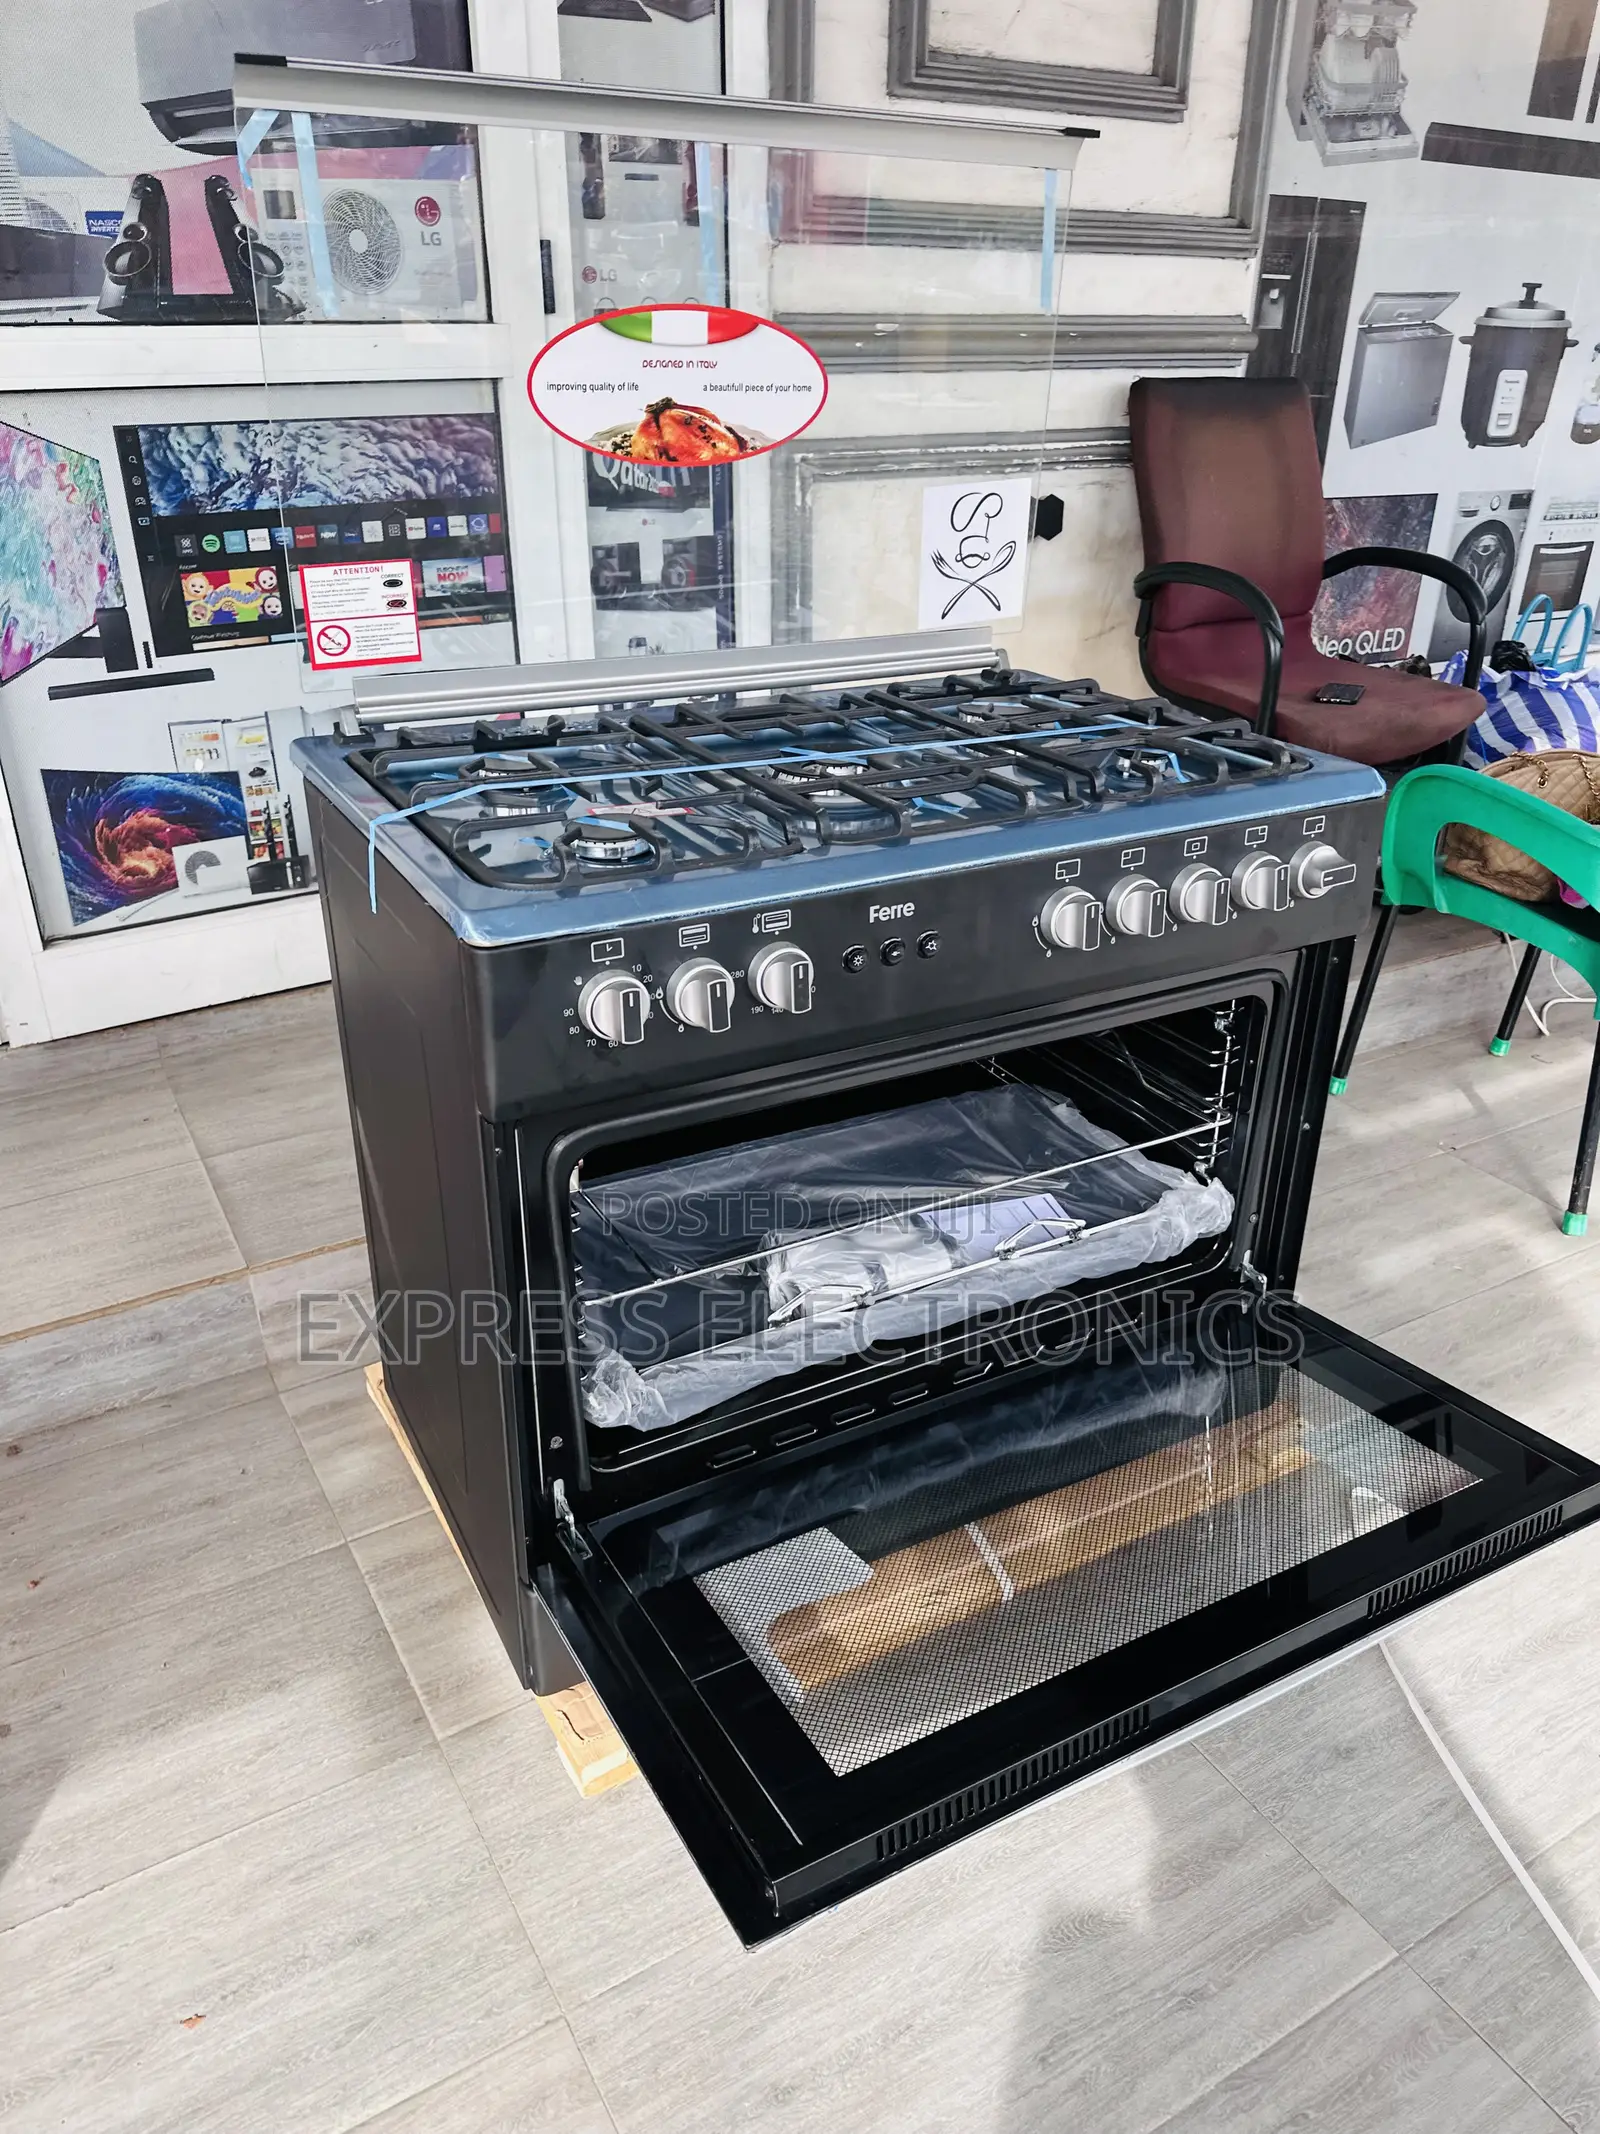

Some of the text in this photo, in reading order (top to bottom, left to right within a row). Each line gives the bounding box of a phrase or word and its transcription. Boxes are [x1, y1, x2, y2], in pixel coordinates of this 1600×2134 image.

[420, 231, 442, 246] LG
[642, 359, 718, 369] DESIGNED IN ITALY
[546, 382, 639, 393] improving quality of life
[702, 383, 812, 394] a beautifull piece of your home
[333, 566, 384, 576] ATTENTION!
[1355, 627, 1406, 656] QLED
[869, 902, 916, 924] Ferre
[631, 964, 642, 973] 10
[643, 974, 653, 984] 20
[563, 1008, 574, 1017] 90
[751, 1005, 764, 1014] 190
[569, 1026, 580, 1035] 80
[586, 1038, 597, 1047] 70
[608, 1040, 619, 1048] 60
